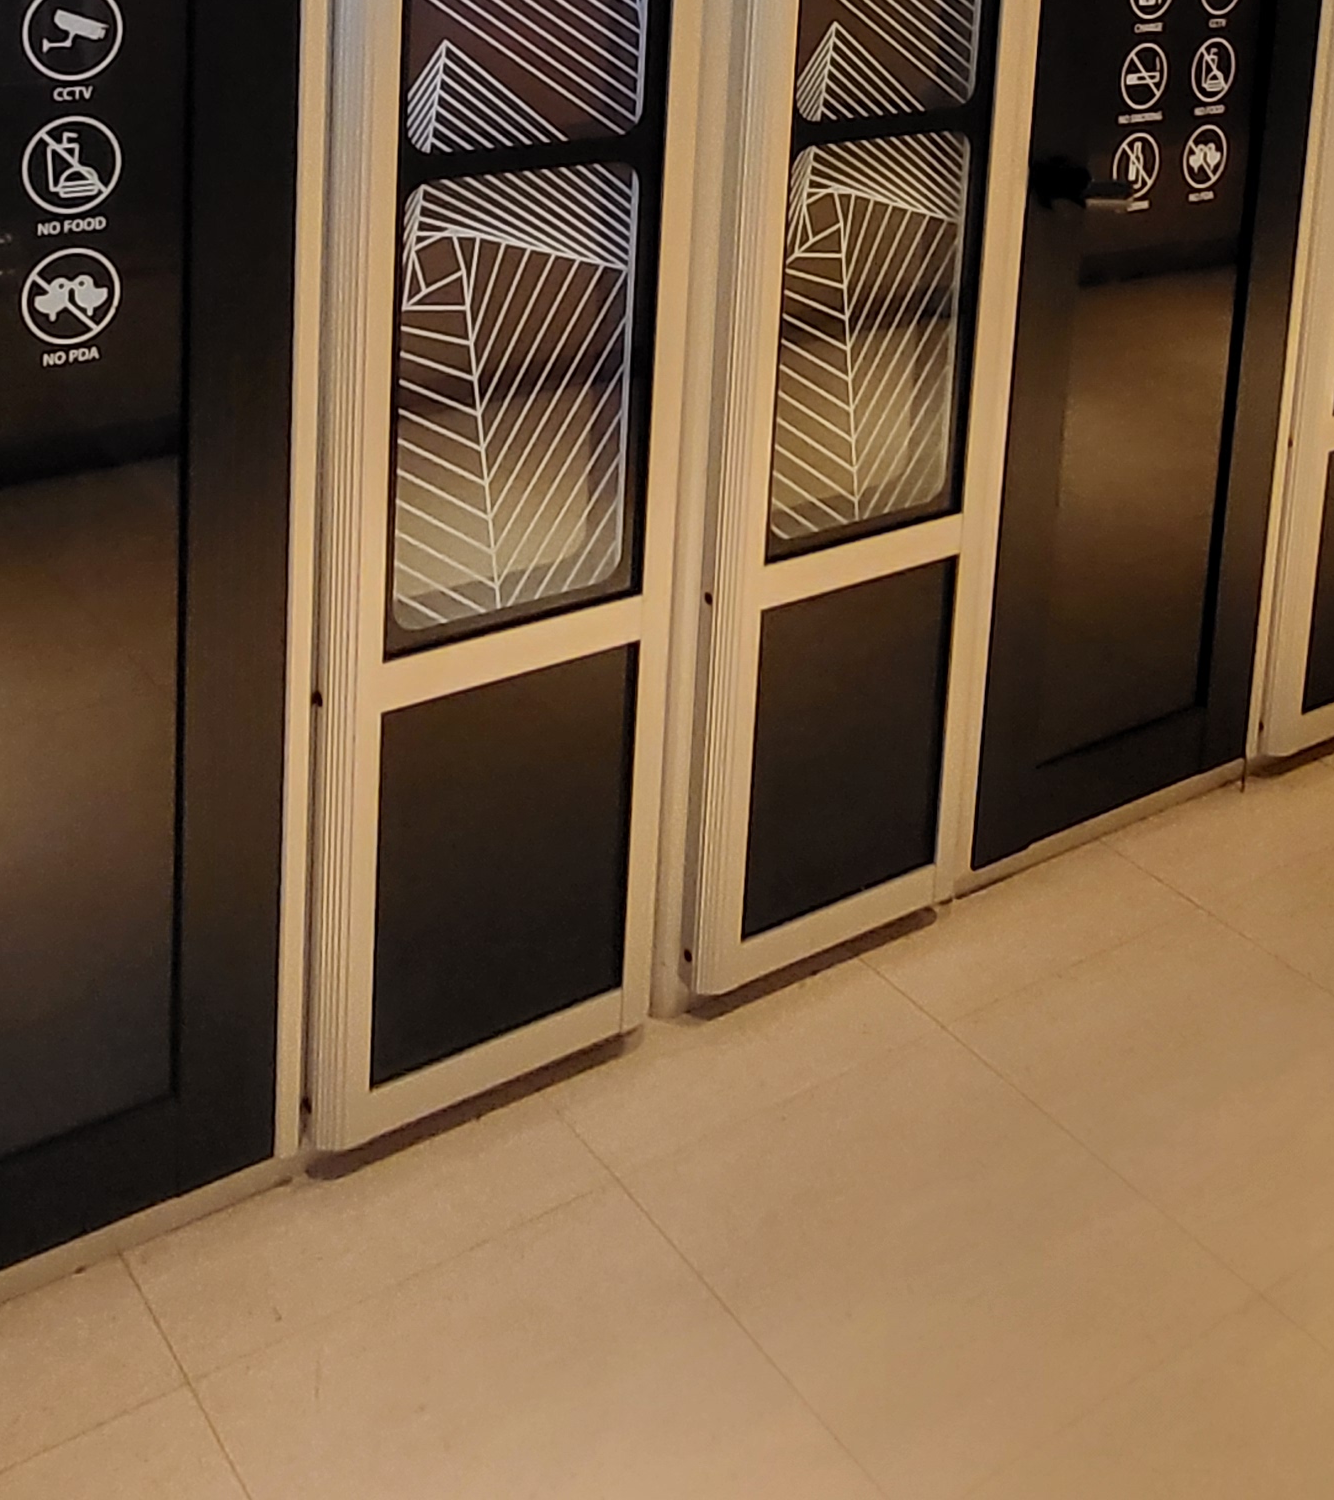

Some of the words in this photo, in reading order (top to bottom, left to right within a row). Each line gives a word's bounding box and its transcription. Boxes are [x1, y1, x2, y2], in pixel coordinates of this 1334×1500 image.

[53, 86, 94, 101] CCTV
[37, 221, 62, 236] NO
[64, 216, 107, 233] FOOD
[43, 351, 67, 366] NO
[69, 346, 100, 362] PDA
